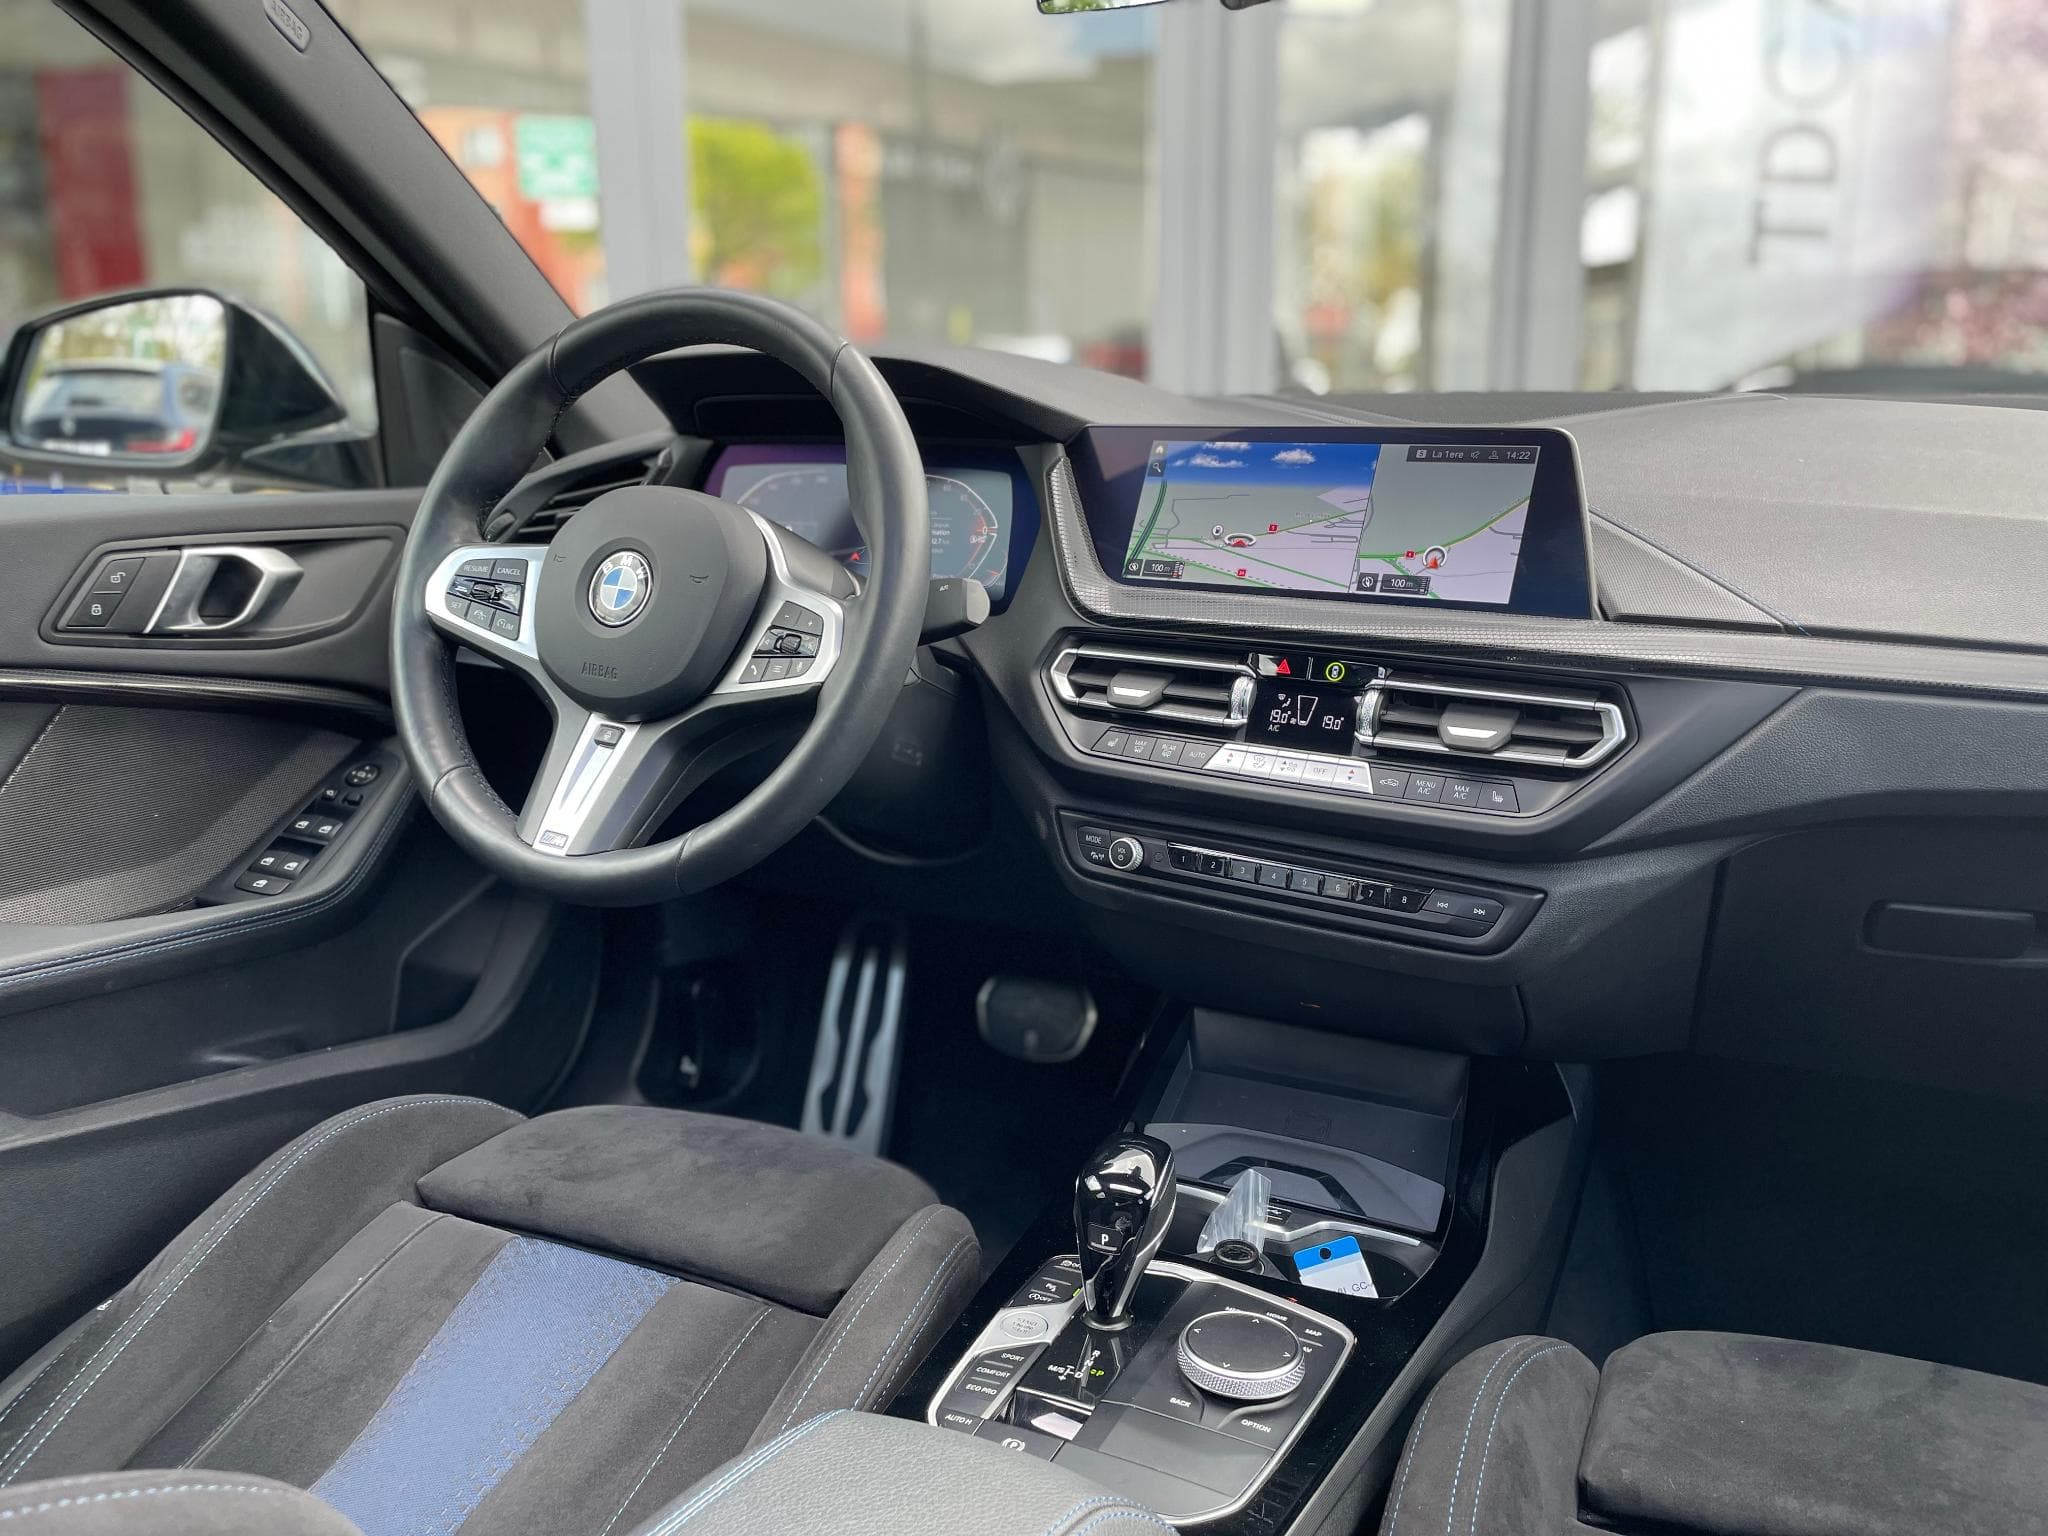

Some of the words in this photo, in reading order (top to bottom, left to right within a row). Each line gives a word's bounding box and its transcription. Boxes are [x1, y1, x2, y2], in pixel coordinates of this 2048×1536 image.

[1432, 450, 1443, 458] La
[1506, 451, 1531, 460] 14:22
[463, 565, 489, 573] RESUME
[497, 567, 521, 576] CANCEL
[1151, 563, 1164, 572] 100
[1390, 578, 1406, 588] 100
[503, 621, 514, 630] LIM
[580, 661, 618, 679] AIRBAG
[1268, 724, 1280, 732] A/C
[1190, 751, 1206, 759] AUTO
[1313, 767, 1328, 775] OFF
[1416, 780, 1436, 789] MENU
[1454, 784, 1470, 792] MAX
[1418, 787, 1430, 795] A/C
[1453, 791, 1467, 800] A/C
[1085, 834, 1102, 844] MODE
[1211, 861, 1216, 869] 2
[1240, 866, 1245, 874] 3
[1271, 872, 1276, 880] 4
[1335, 883, 1341, 892] 6
[1368, 889, 1374, 898] 7
[1401, 895, 1407, 904] 8
[1101, 1233, 1109, 1246] P
[1304, 1328, 1323, 1337] MAP
[1000, 1352, 1024, 1362] SPORT
[976, 1366, 1011, 1378] COMFORT
[966, 1383, 981, 1391] ECO
[981, 1386, 998, 1395] PRO
[1169, 1397, 1191, 1408] BACK
[945, 1413, 966, 1423] AUTO
[1241, 1419, 1272, 1433] OPTION
